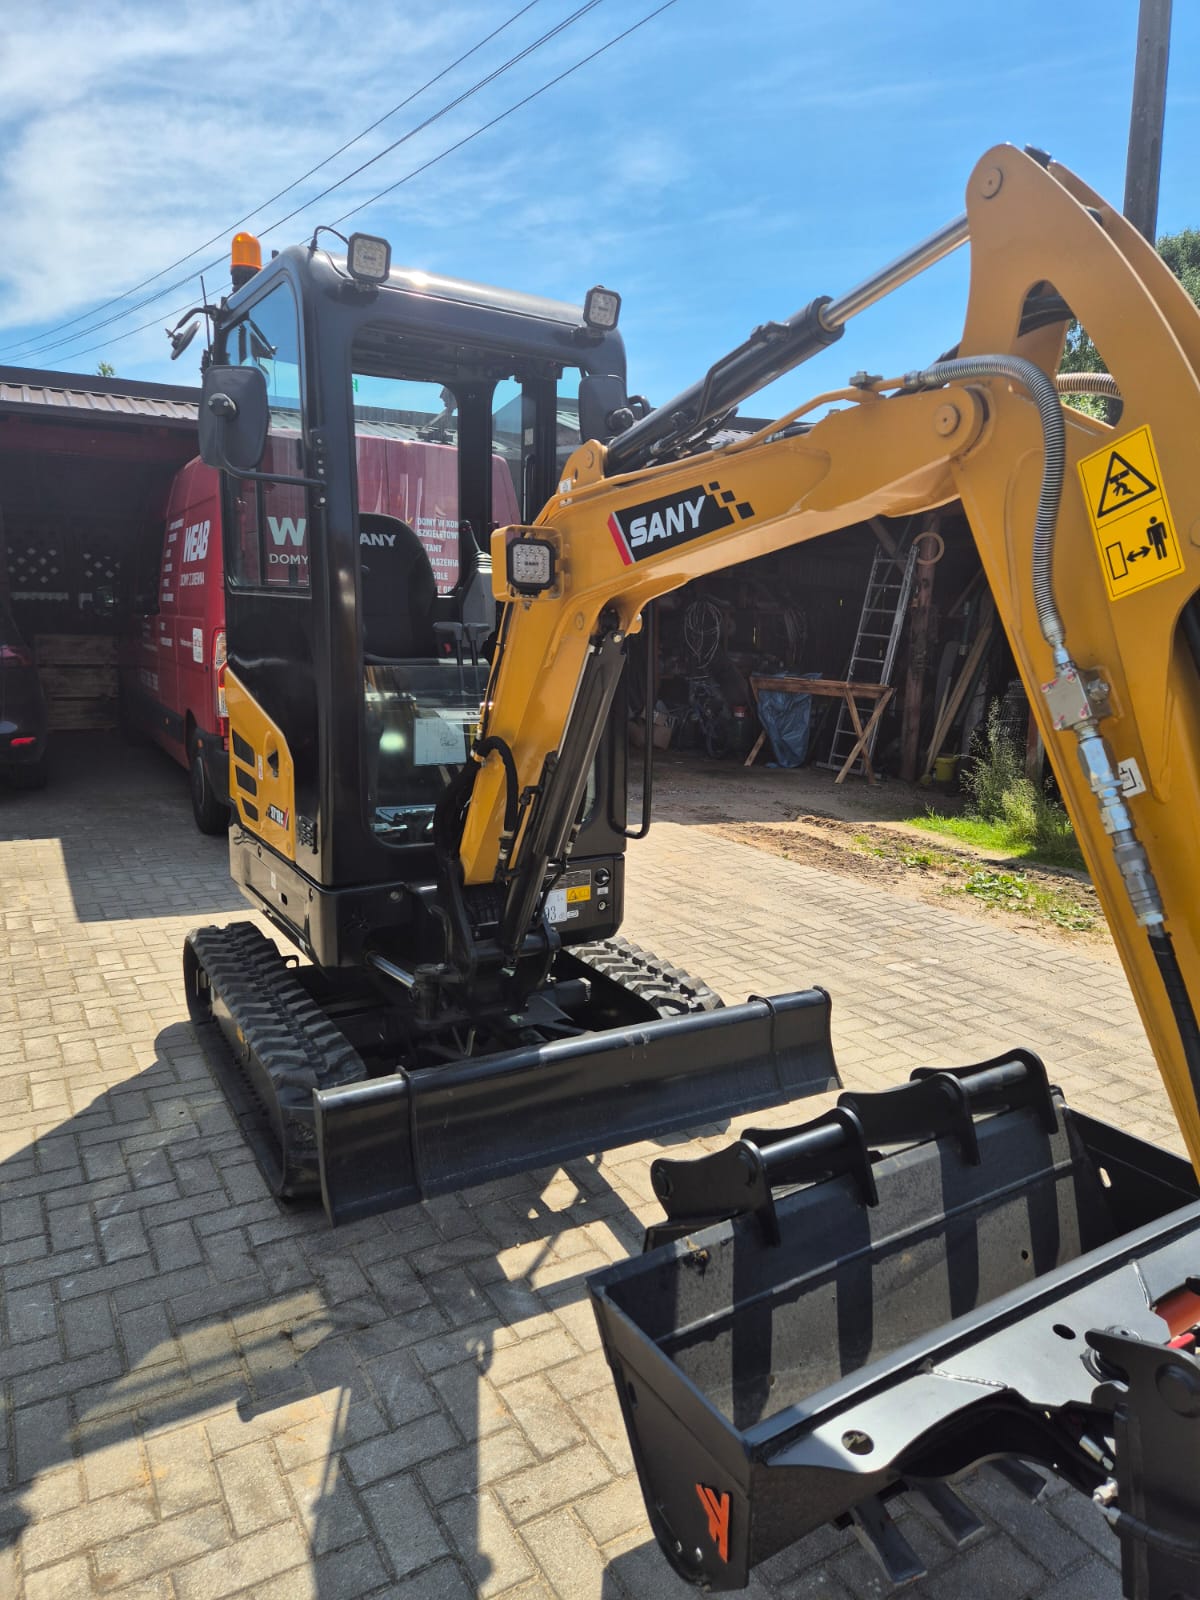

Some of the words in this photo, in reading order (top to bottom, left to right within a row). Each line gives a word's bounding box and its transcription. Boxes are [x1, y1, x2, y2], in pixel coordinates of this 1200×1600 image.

[630, 495, 706, 548] SANY
[183, 520, 210, 562] WEAB
[360, 533, 396, 546] ANY
[269, 553, 309, 565] DOMY
